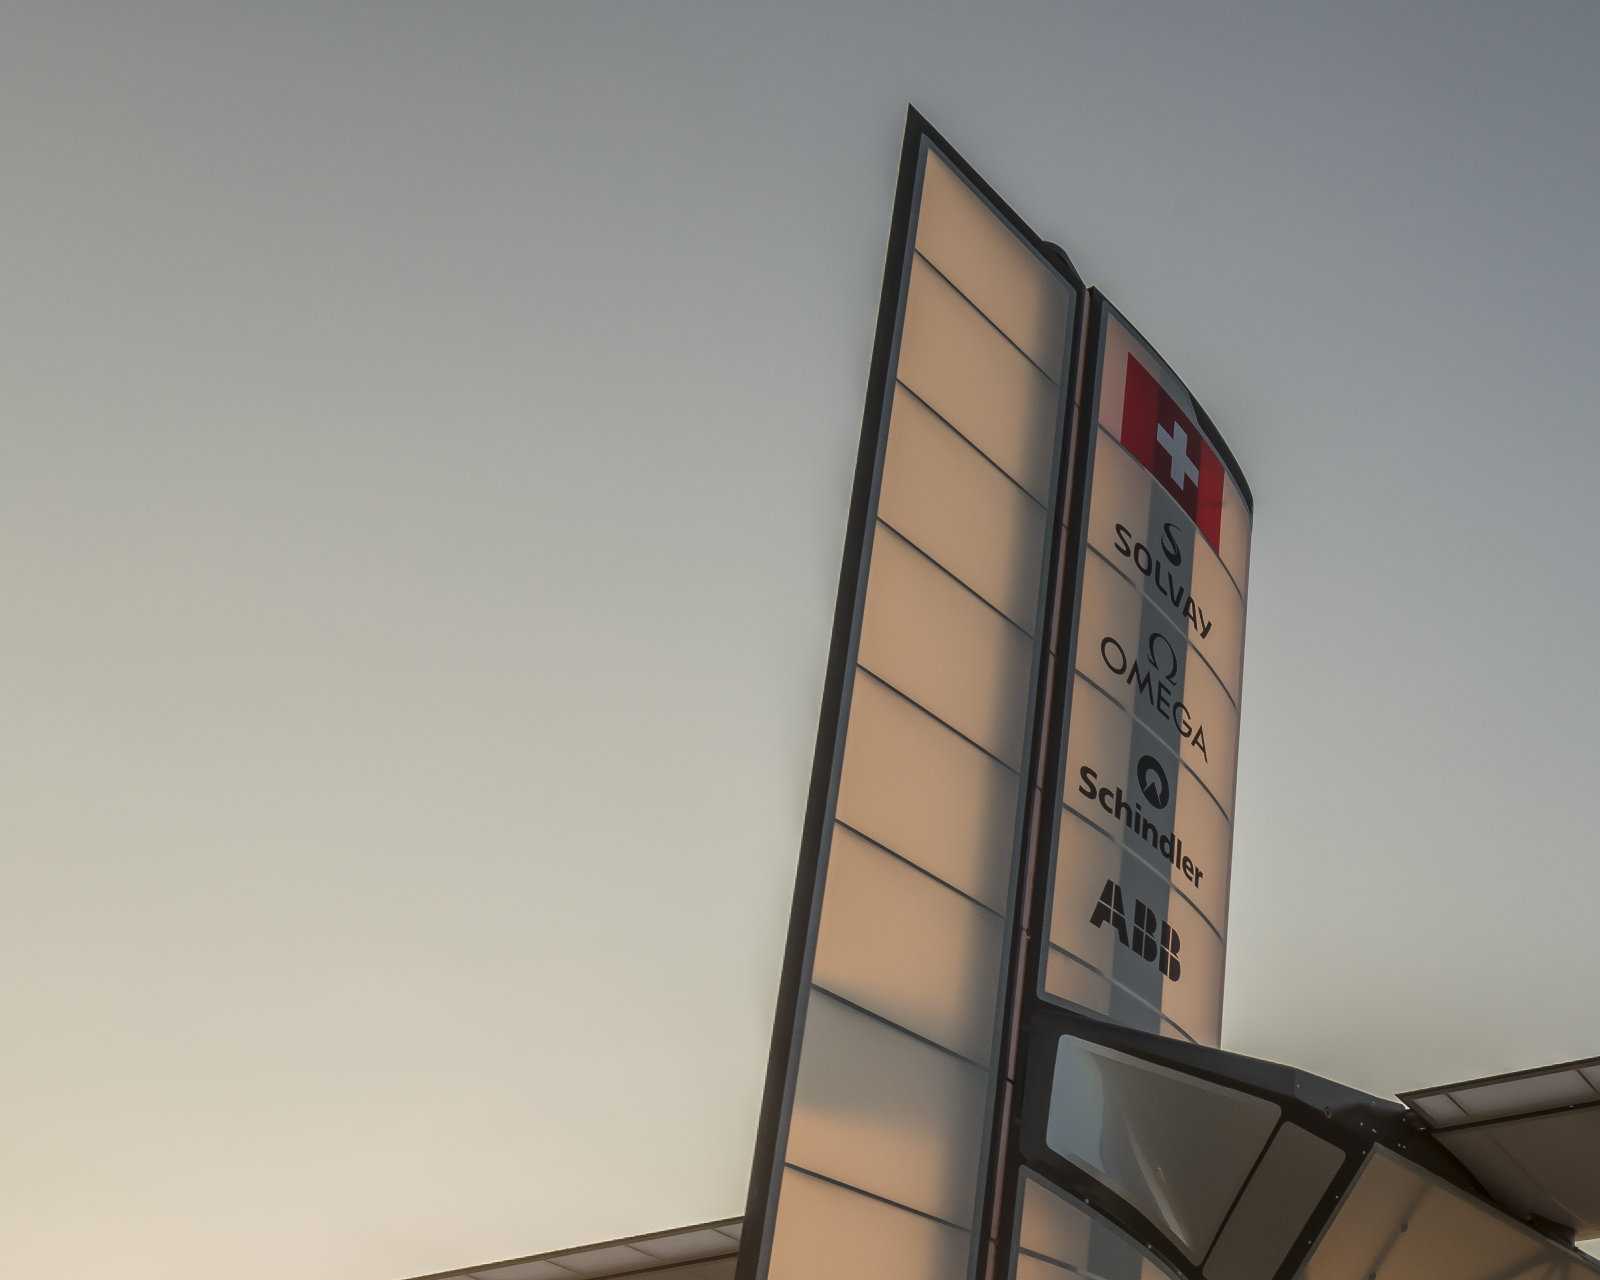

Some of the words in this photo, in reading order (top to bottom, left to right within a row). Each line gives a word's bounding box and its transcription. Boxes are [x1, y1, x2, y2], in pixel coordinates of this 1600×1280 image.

[1114, 523, 1212, 639] SOLVAY
[1100, 636, 1208, 764] OMEGA
[1078, 765, 1204, 888] Schindler
[1089, 879, 1181, 982] ABB
